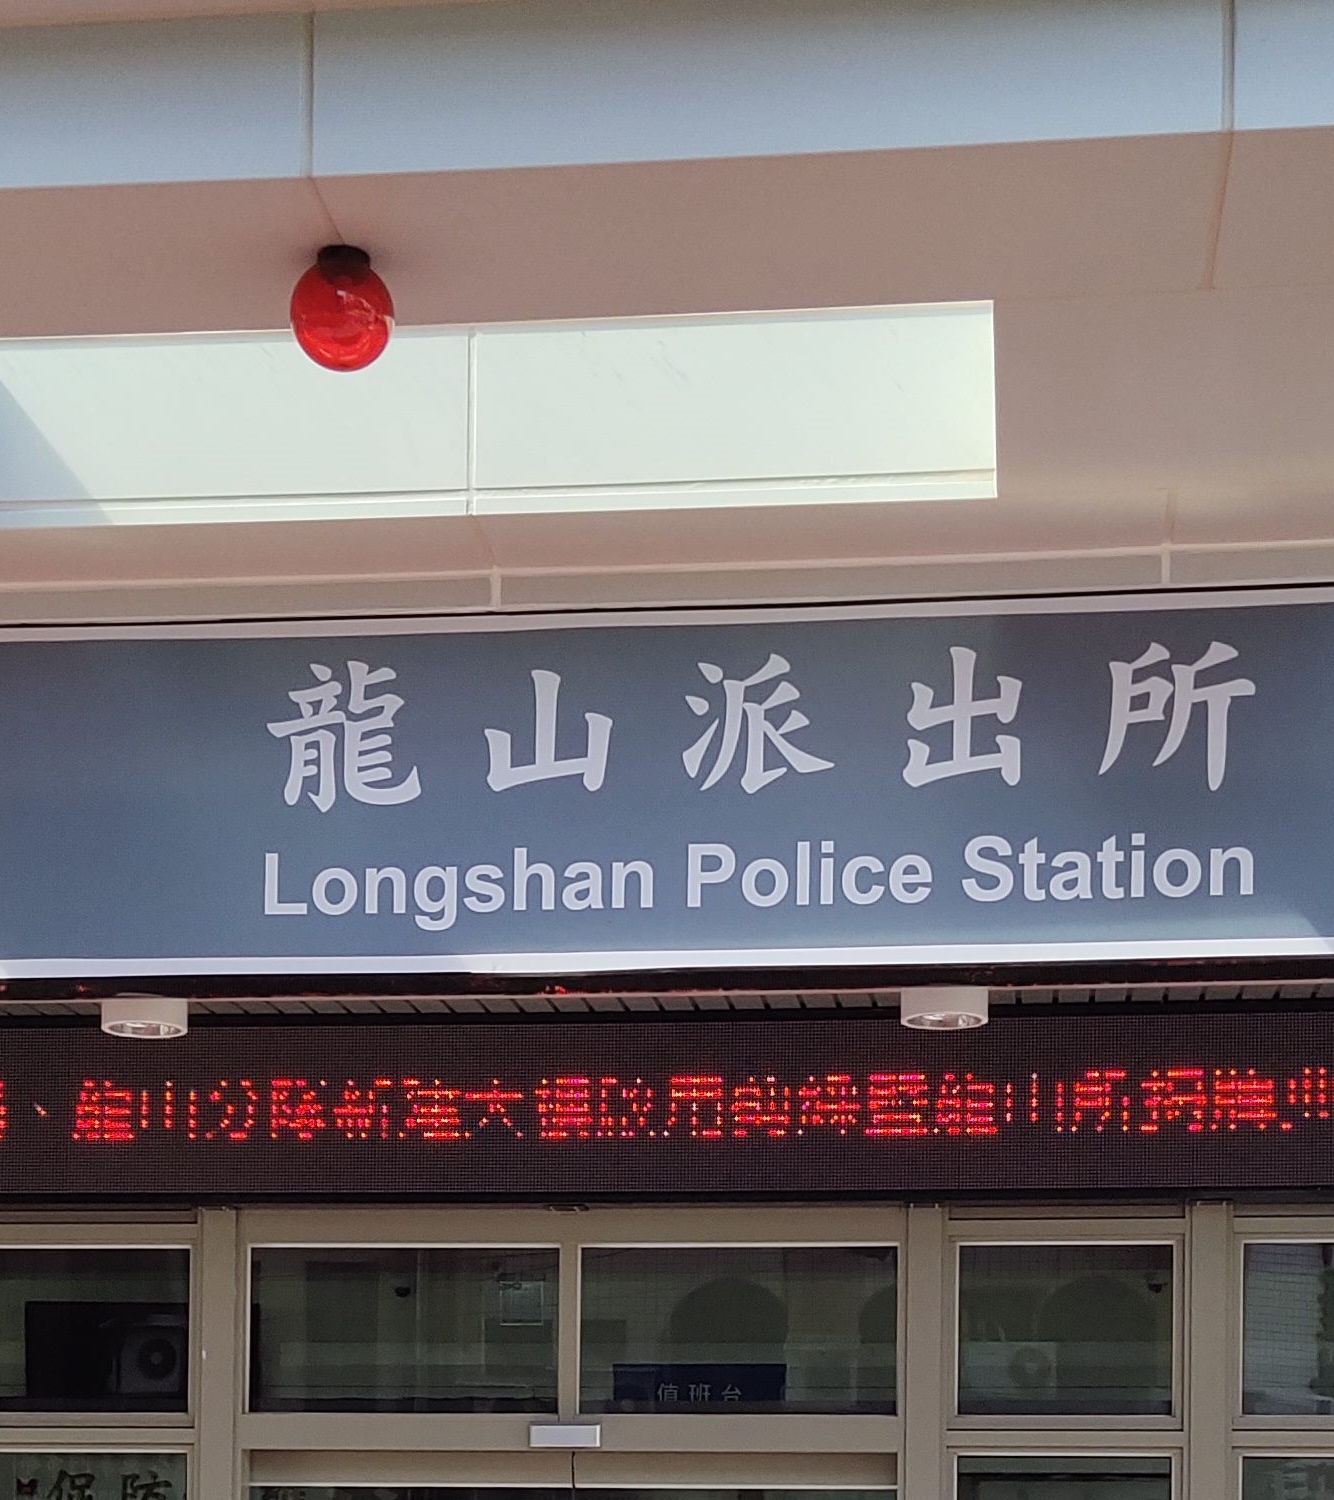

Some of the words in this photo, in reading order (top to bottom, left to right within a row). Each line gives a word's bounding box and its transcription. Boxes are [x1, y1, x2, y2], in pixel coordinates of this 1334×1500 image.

[267, 647, 1255, 812] 龍山派出所
[265, 848, 653, 930] Longshan
[688, 842, 932, 907] Police
[962, 836, 1253, 901] Station
